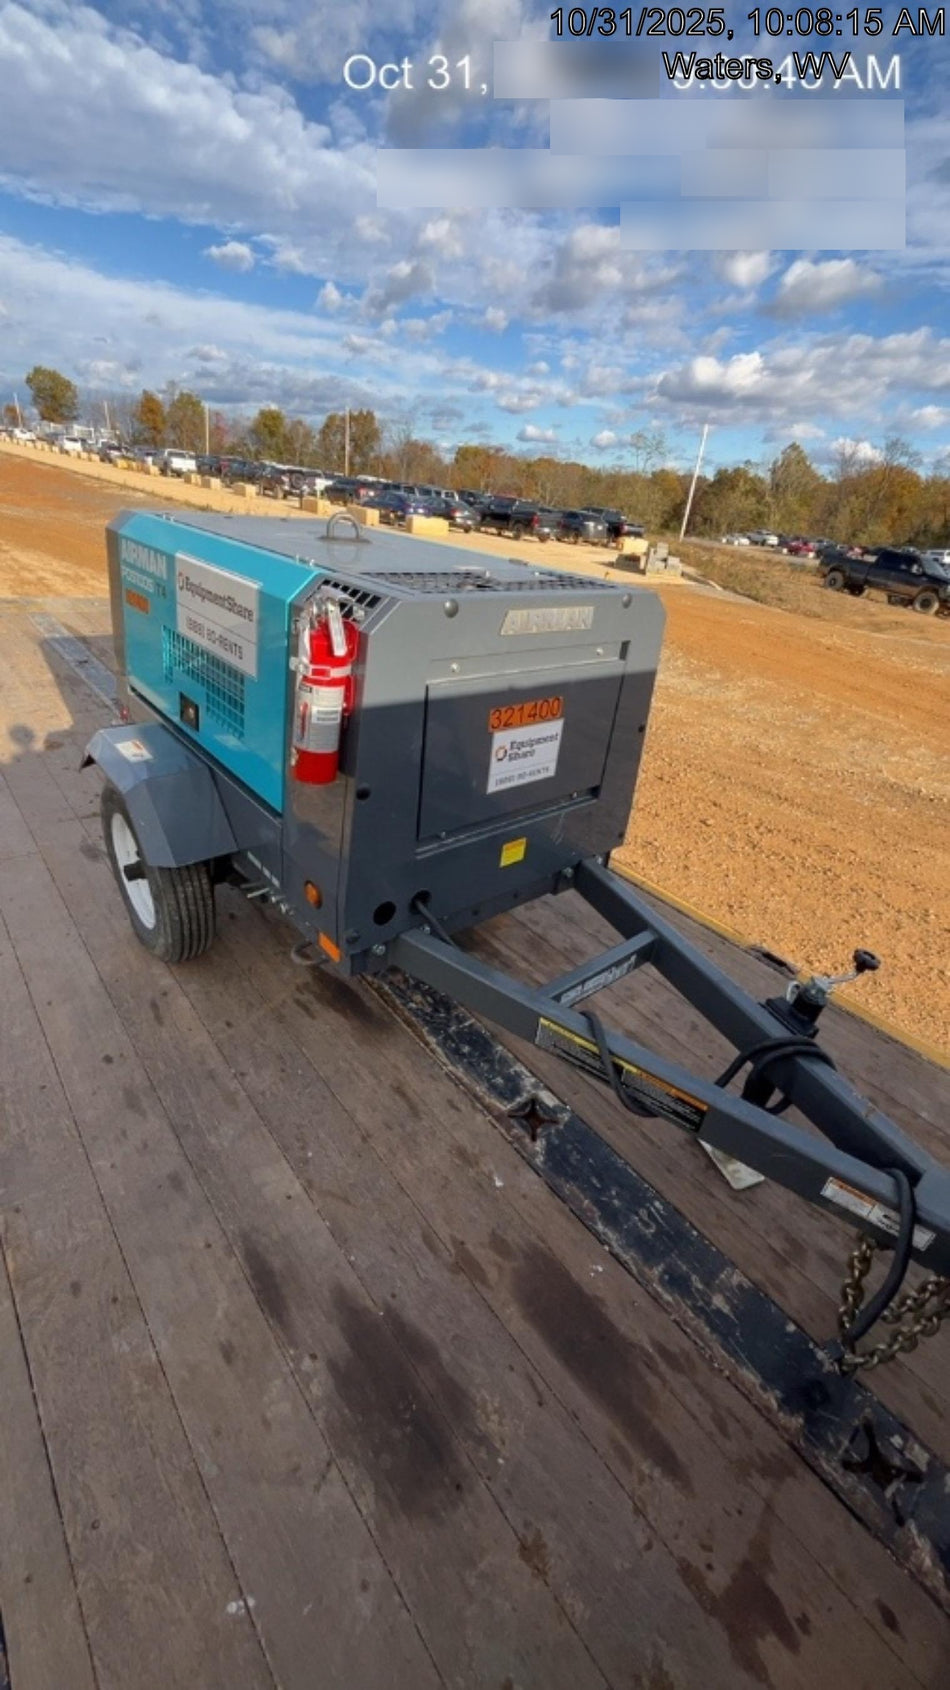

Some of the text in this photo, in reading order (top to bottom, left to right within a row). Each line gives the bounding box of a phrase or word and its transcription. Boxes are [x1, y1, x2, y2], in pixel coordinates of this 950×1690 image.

[185, 575, 254, 623] EquipmentShare
[490, 697, 562, 729] 321400
[509, 731, 559, 751] Equipment
[508, 749, 535, 761] Share
